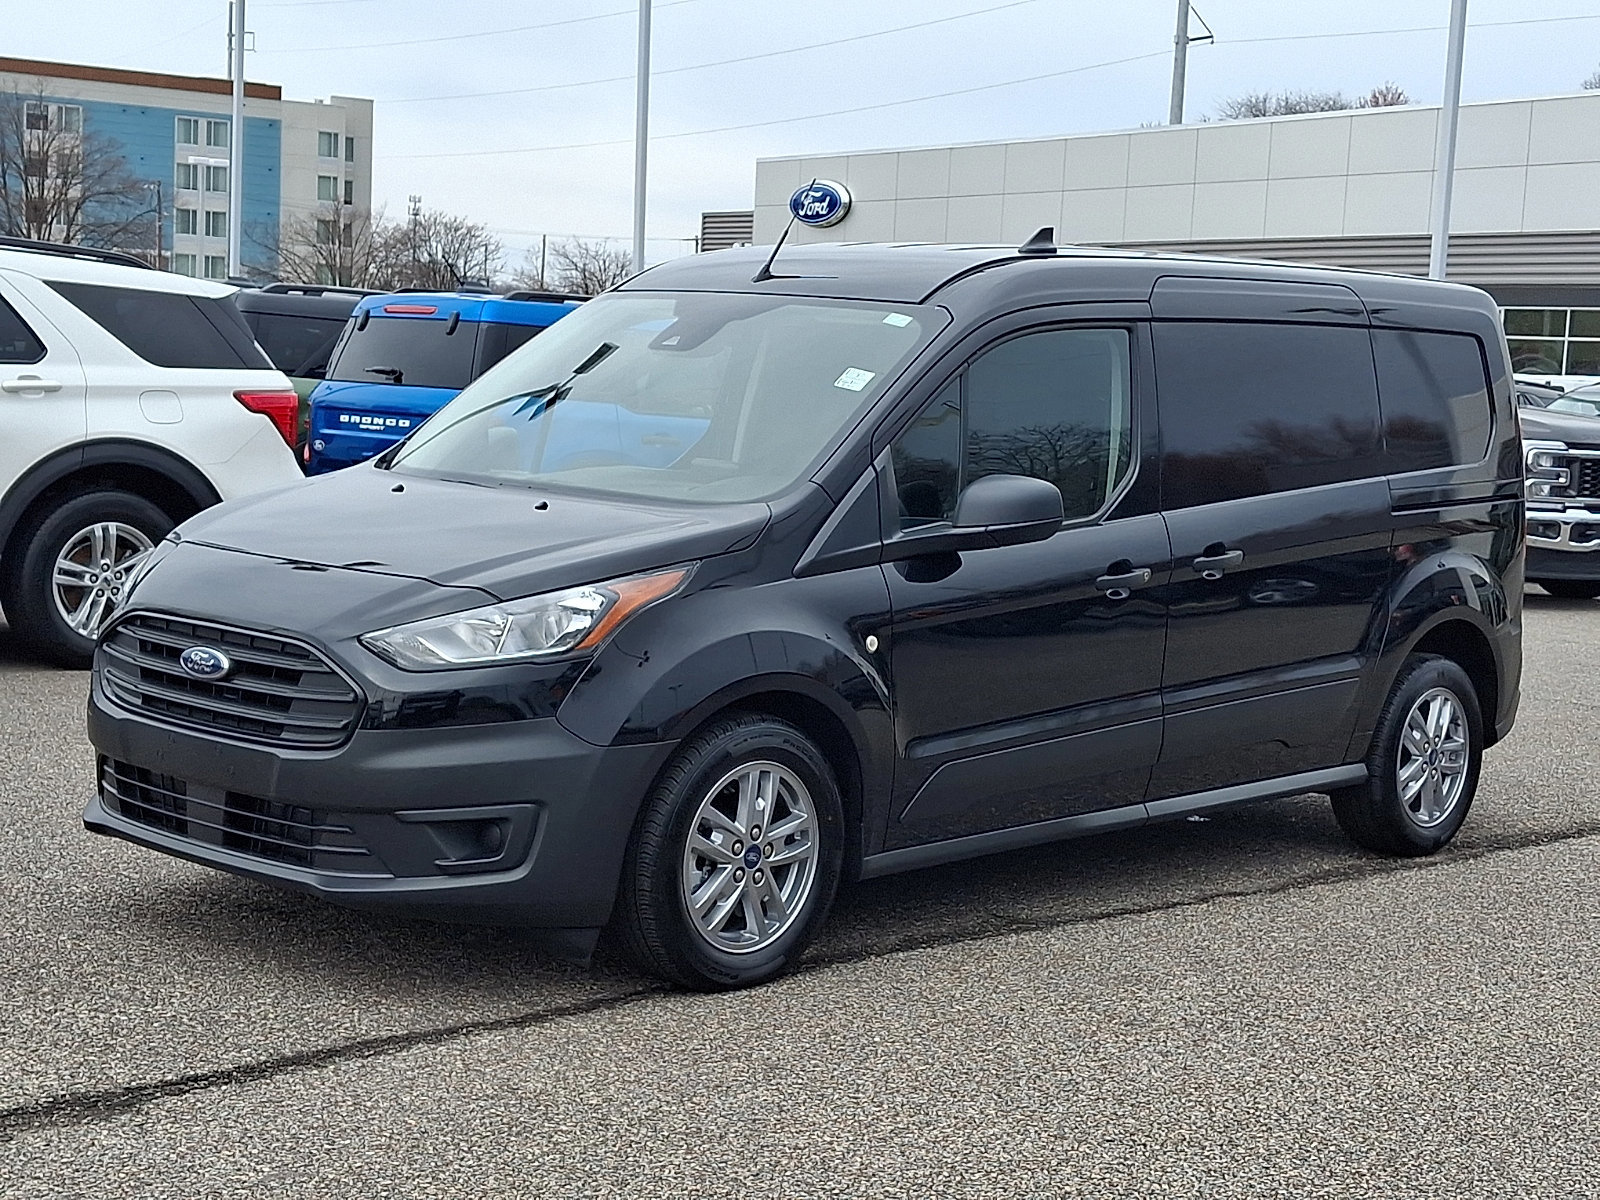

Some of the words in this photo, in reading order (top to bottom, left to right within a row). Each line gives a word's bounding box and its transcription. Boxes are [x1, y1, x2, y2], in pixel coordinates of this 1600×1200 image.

[799, 191, 830, 216] Ford
[339, 414, 410, 428] BRONCO
[187, 650, 215, 673] Ford
